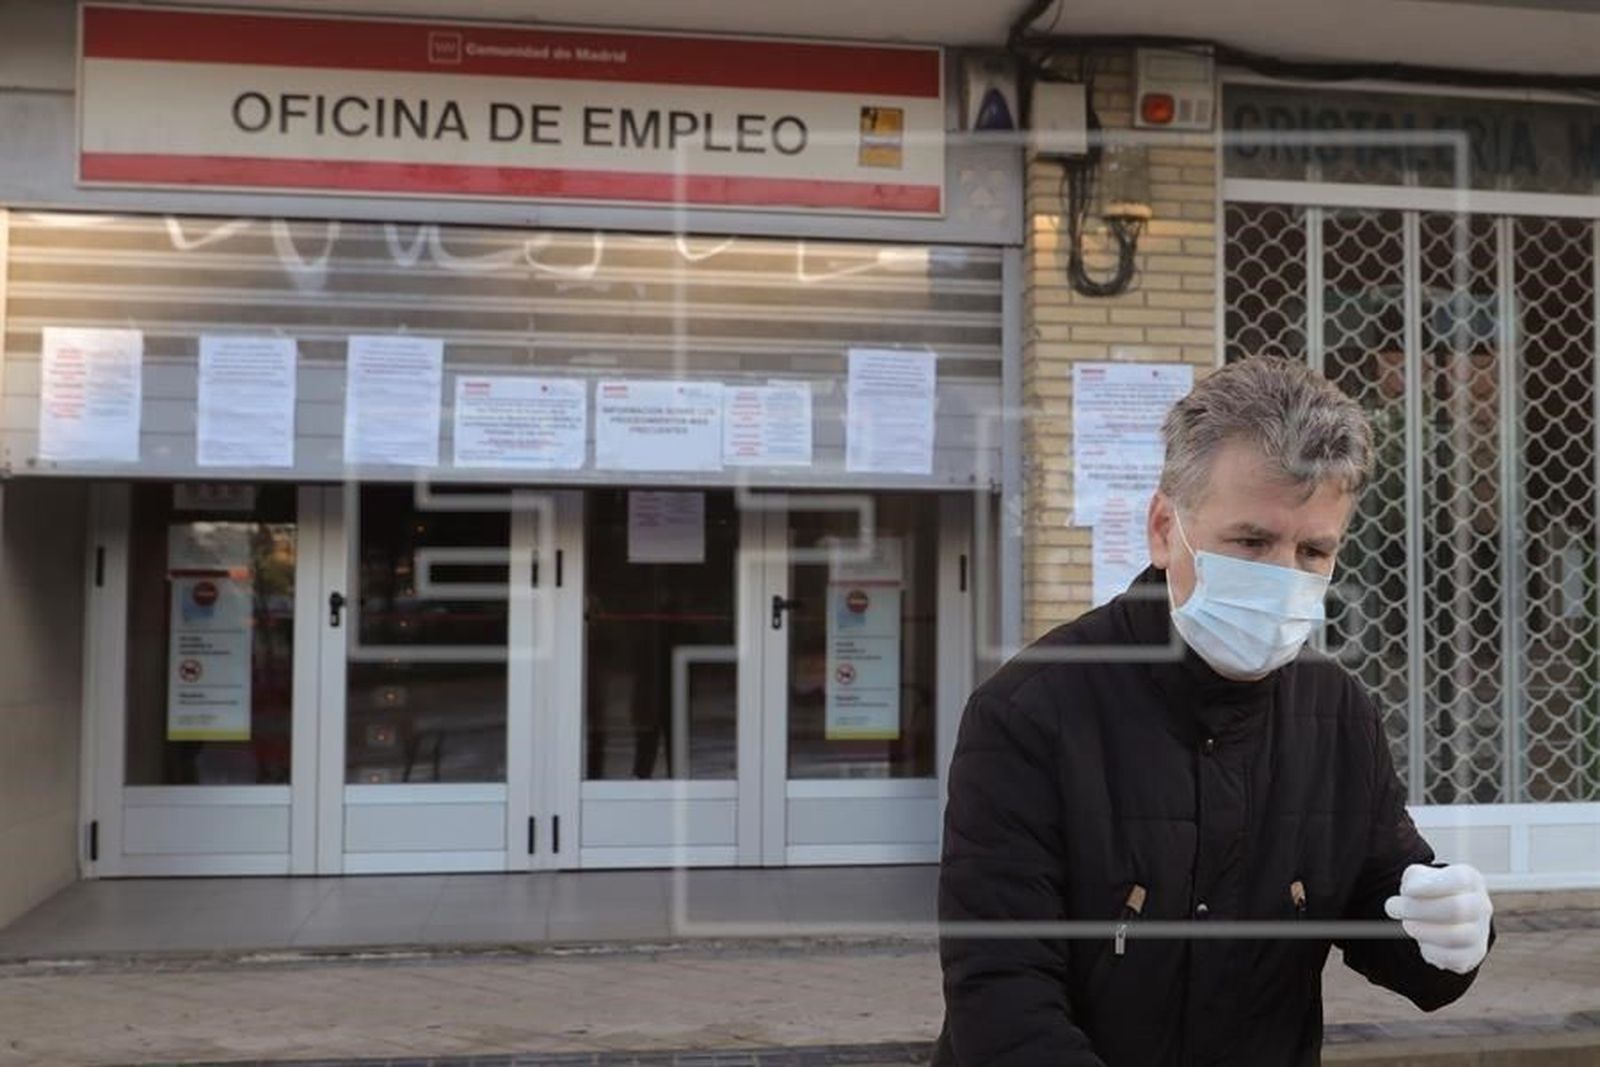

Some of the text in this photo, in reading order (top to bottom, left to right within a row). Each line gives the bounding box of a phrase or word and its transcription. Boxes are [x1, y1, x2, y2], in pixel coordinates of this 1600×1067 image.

[464, 41, 628, 64] Comunidad de Madrid
[232, 90, 809, 157] OFICINA DE EMPLEO
